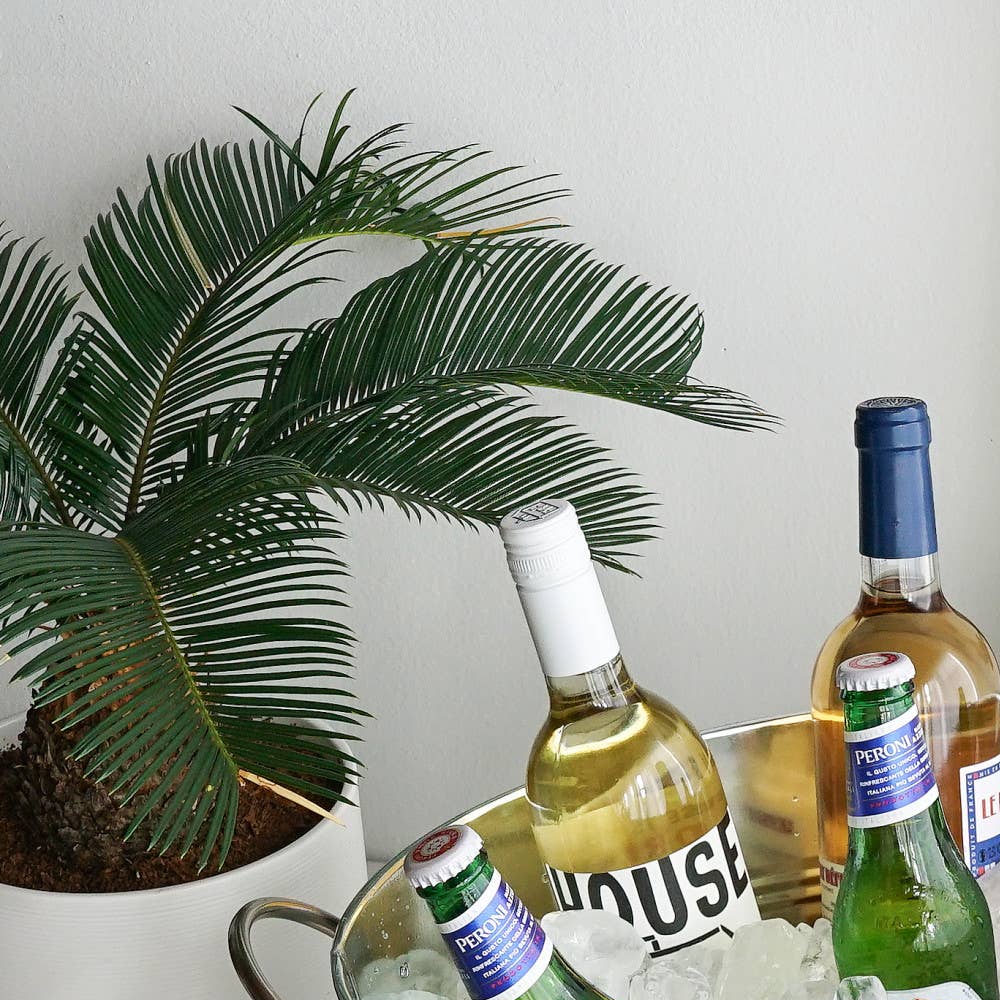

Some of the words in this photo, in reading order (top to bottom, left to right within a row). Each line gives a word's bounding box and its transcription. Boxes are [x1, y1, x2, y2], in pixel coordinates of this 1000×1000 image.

[855, 735, 912, 765] PERONI
[873, 764, 897, 775] GUSTO
[867, 784, 896, 796] ITALIANA
[981, 794, 996, 819] LE
[455, 904, 509, 953] PERONI
[482, 937, 503, 957] GUSTO
